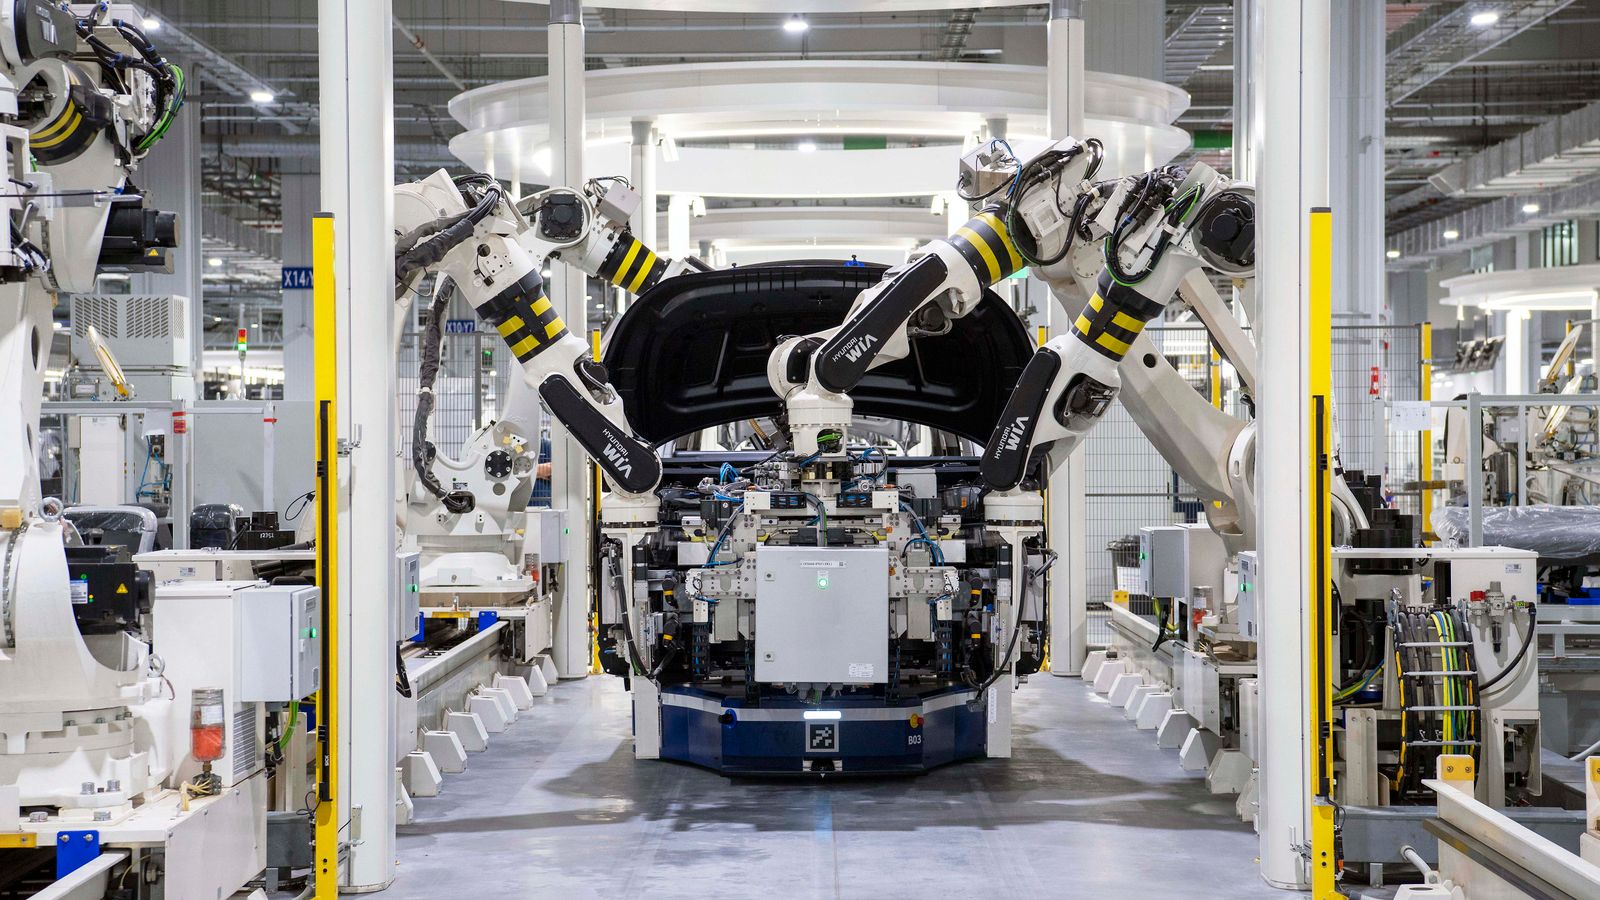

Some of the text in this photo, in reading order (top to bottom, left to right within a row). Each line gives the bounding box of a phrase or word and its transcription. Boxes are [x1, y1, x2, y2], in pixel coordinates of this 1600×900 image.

[832, 336, 858, 362] HYUNDAI
[602, 428, 629, 457] HYUNDAI
[994, 426, 1011, 460] HYUNDAI
[908, 734, 922, 745] B03
